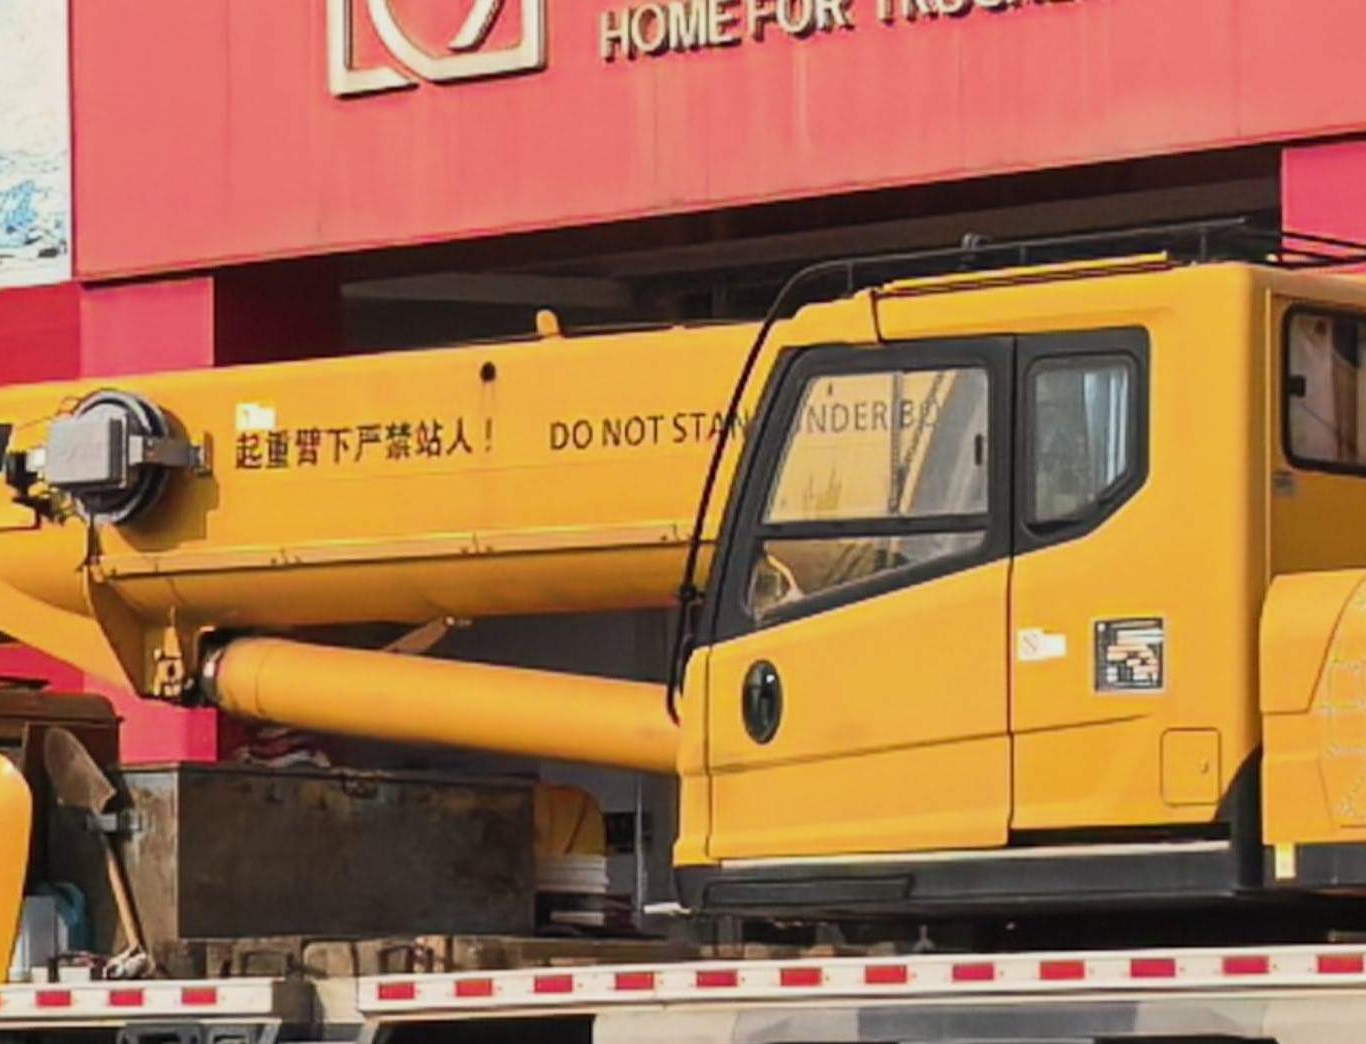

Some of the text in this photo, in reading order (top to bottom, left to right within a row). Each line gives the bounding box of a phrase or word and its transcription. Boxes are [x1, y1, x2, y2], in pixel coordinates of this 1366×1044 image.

[598, 0, 739, 60] HOME
[549, 420, 594, 452] DO
[601, 414, 664, 448] NOT
[672, 408, 749, 444] STAN
[806, 400, 888, 434] NDER
